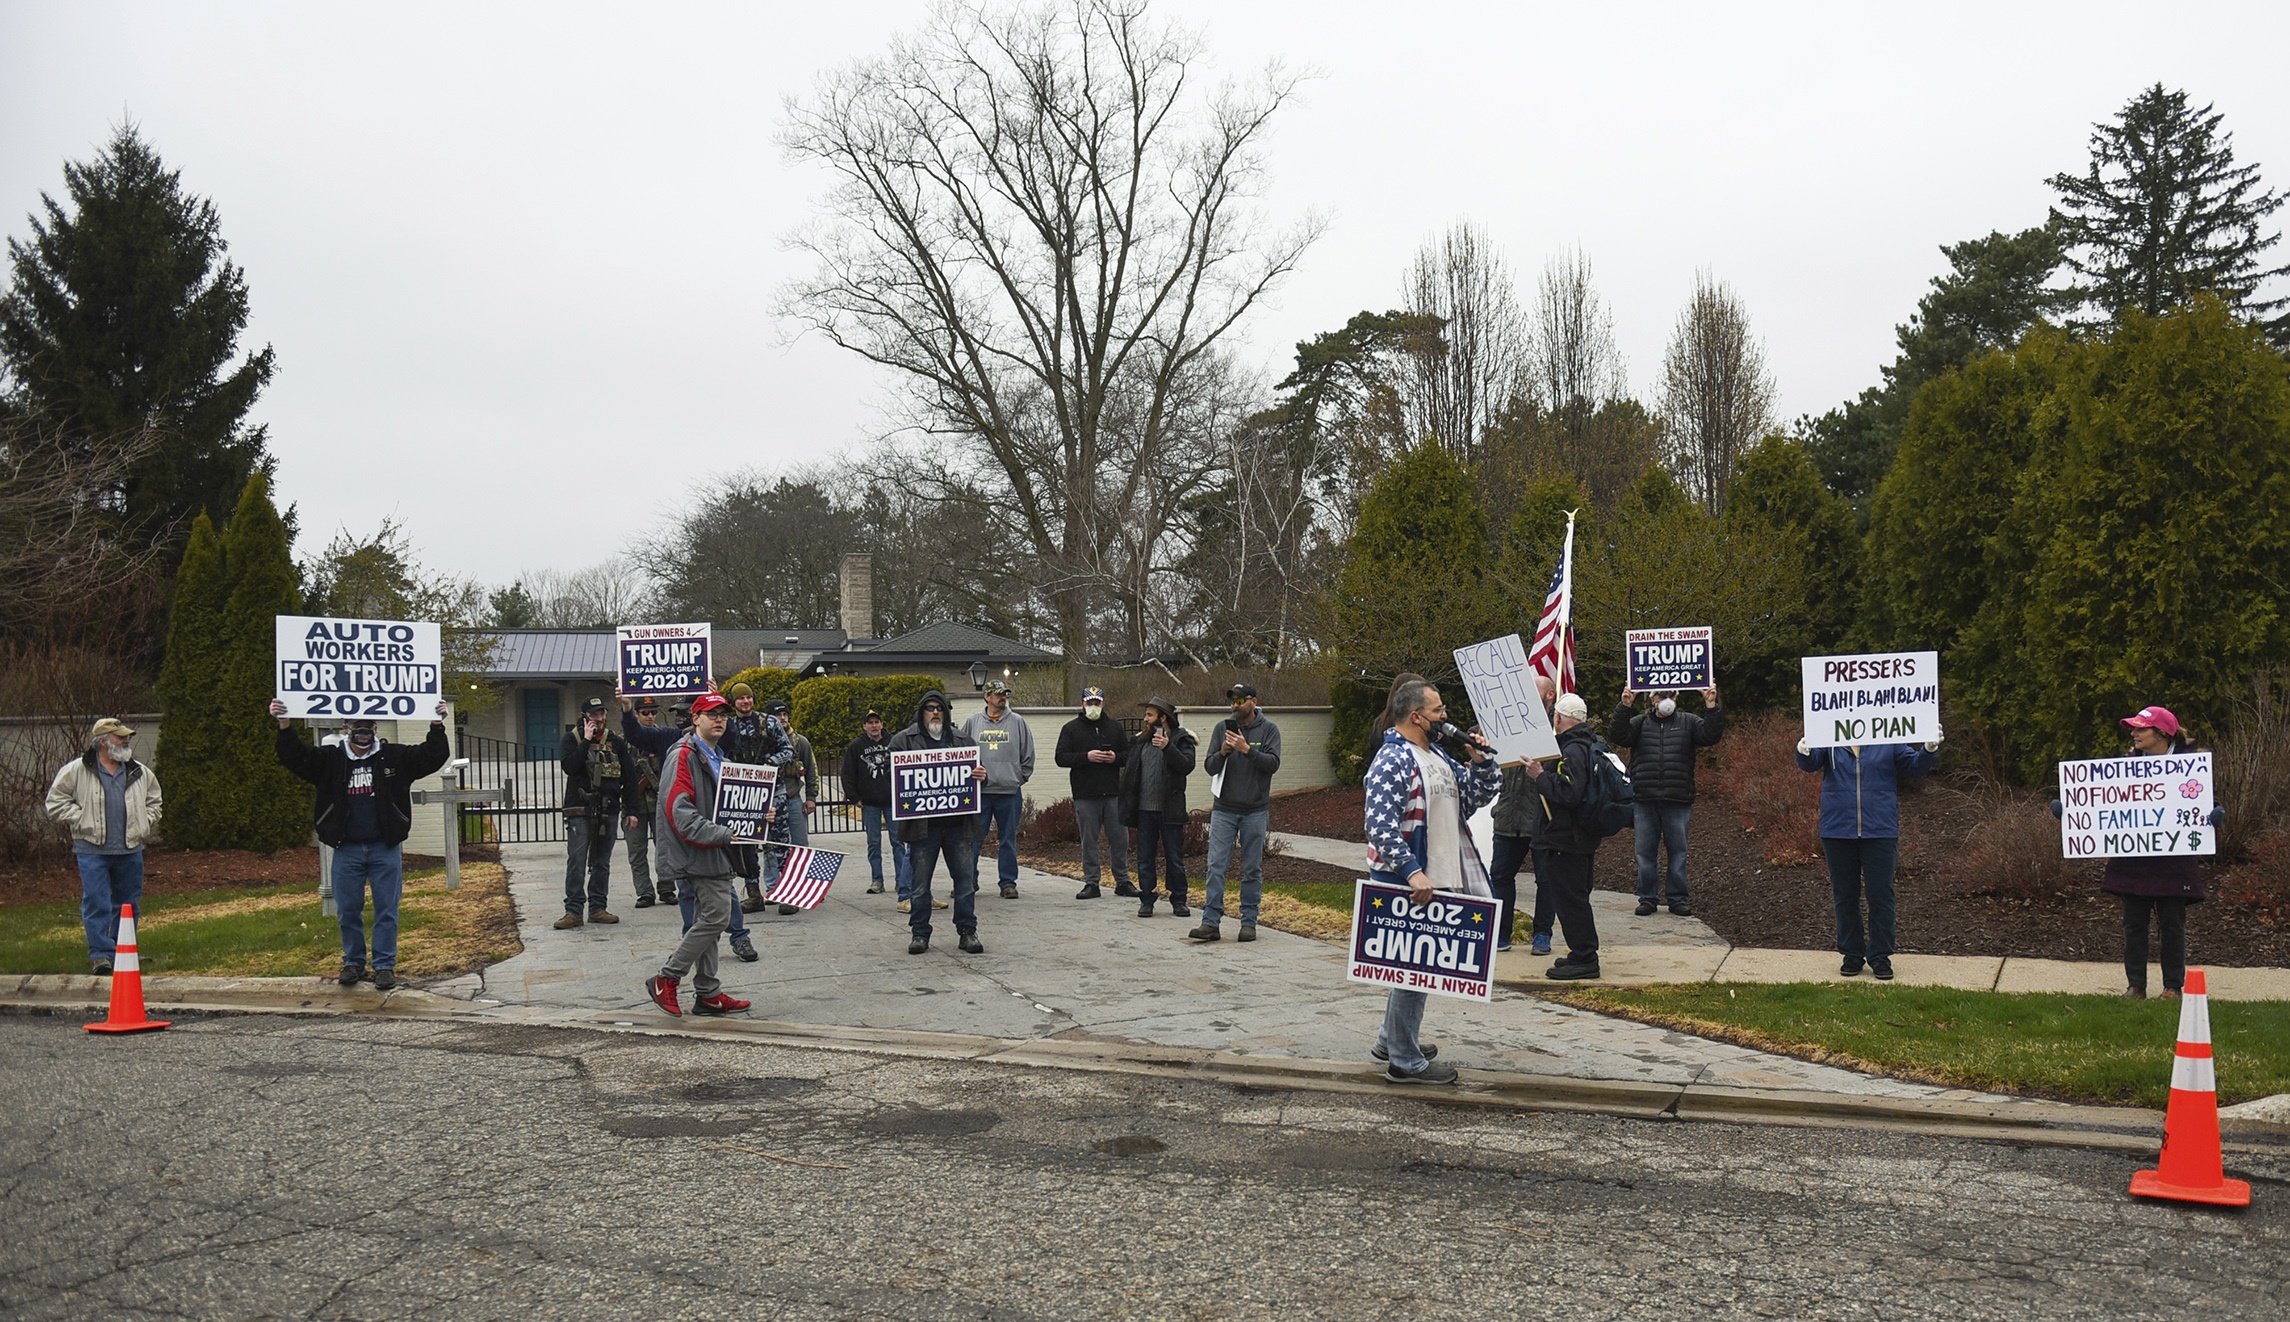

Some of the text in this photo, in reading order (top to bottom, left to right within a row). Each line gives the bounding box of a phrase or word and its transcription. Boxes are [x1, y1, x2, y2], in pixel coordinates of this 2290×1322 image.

[305, 622, 413, 642] AUTO
[634, 628, 691, 638] GUN OWNERS 4
[1629, 633, 1655, 641] DRAIN
[1678, 630, 1708, 639] SWAMP
[305, 641, 414, 662] WORKERS
[626, 643, 701, 666] TRUMP
[1456, 638, 1524, 679] RECALL
[1635, 644, 1704, 664] TRUMP
[284, 663, 434, 692] FOR TRUMP
[1649, 671, 1691, 685] 2020
[1824, 658, 1915, 682] PRESSERS
[642, 674, 688, 689] 2020
[1466, 669, 1526, 710] WHIT
[307, 694, 415, 715] 2020
[1479, 702, 1537, 740] MER
[1835, 719, 1865, 742] NO
[894, 750, 977, 764] DRAIN THE SWAMP
[722, 766, 775, 780] DRAIN THE SWAMP
[900, 765, 972, 790] TRUMP
[2064, 759, 2195, 784] NO MOTHERS DAY
[723, 785, 768, 810] TRUMP
[915, 795, 958, 811] 2020
[2066, 787, 2088, 807] NO
[2068, 808, 2164, 830] NO FAMILY
[2069, 835, 2096, 855] NO
[2105, 831, 2180, 853] MONEY
[1392, 897, 1463, 925] 2020
[1409, 921, 1456, 935] AMERICA
[1457, 928, 1484, 940] KEEP
[1365, 928, 1480, 973] TRUMP
[1353, 964, 1486, 996] DRAIN THE SWAMP
